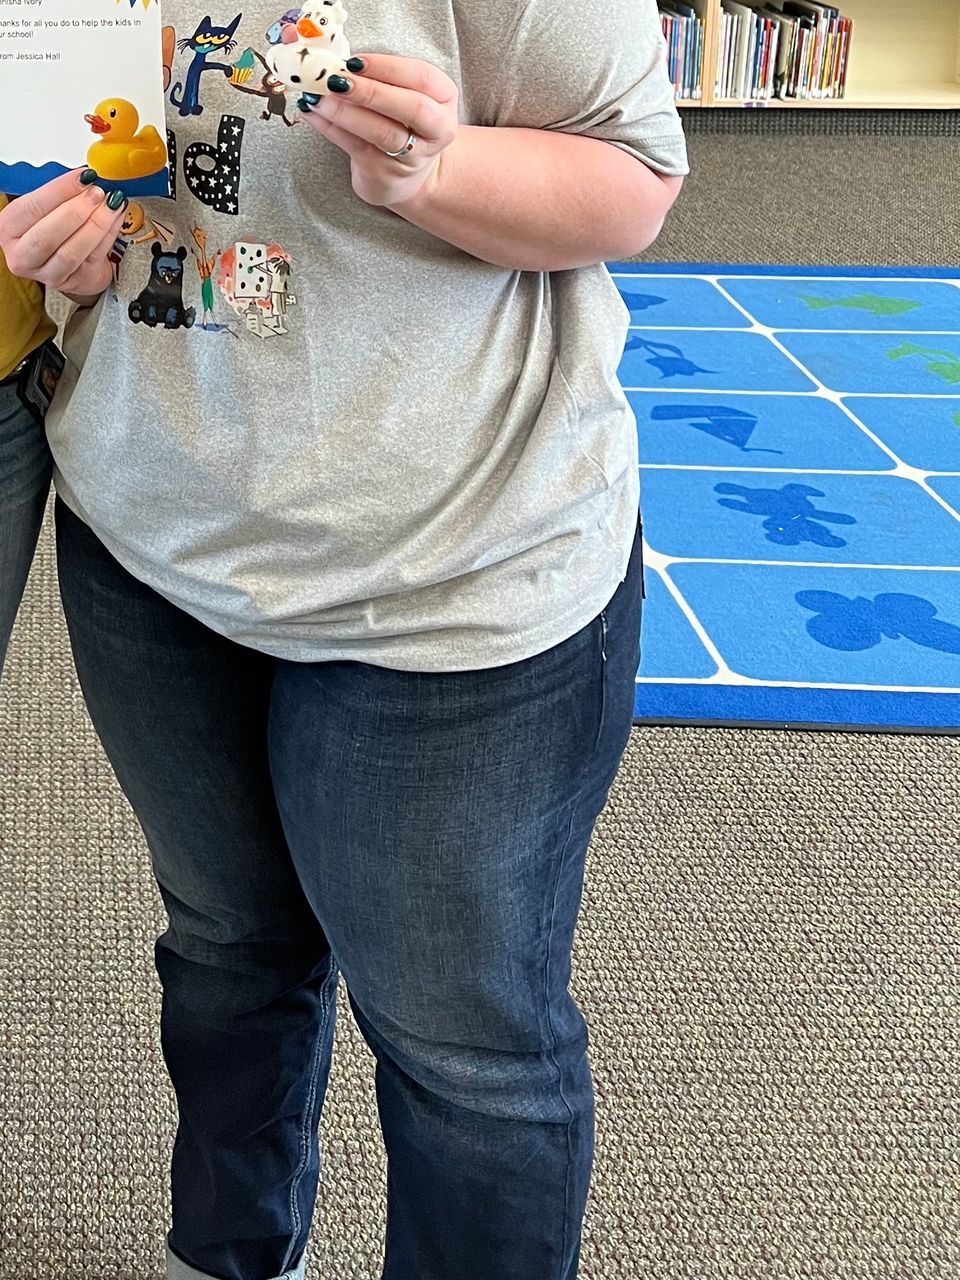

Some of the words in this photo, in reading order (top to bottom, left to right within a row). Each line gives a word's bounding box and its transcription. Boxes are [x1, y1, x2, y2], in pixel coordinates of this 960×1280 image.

[21, 19, 32, 27] for
[33, 19, 43, 27] all
[44, 21, 59, 29] you
[60, 19, 70, 27] do
[71, 19, 80, 27] to
[81, 19, 99, 28] help
[100, 19, 113, 27] the
[115, 18, 132, 27] kids
[133, 19, 142, 27] in
[7, 30, 34, 39] school!
[15, 52, 44, 60] Jessica
[45, 52, 61, 60] Hall
